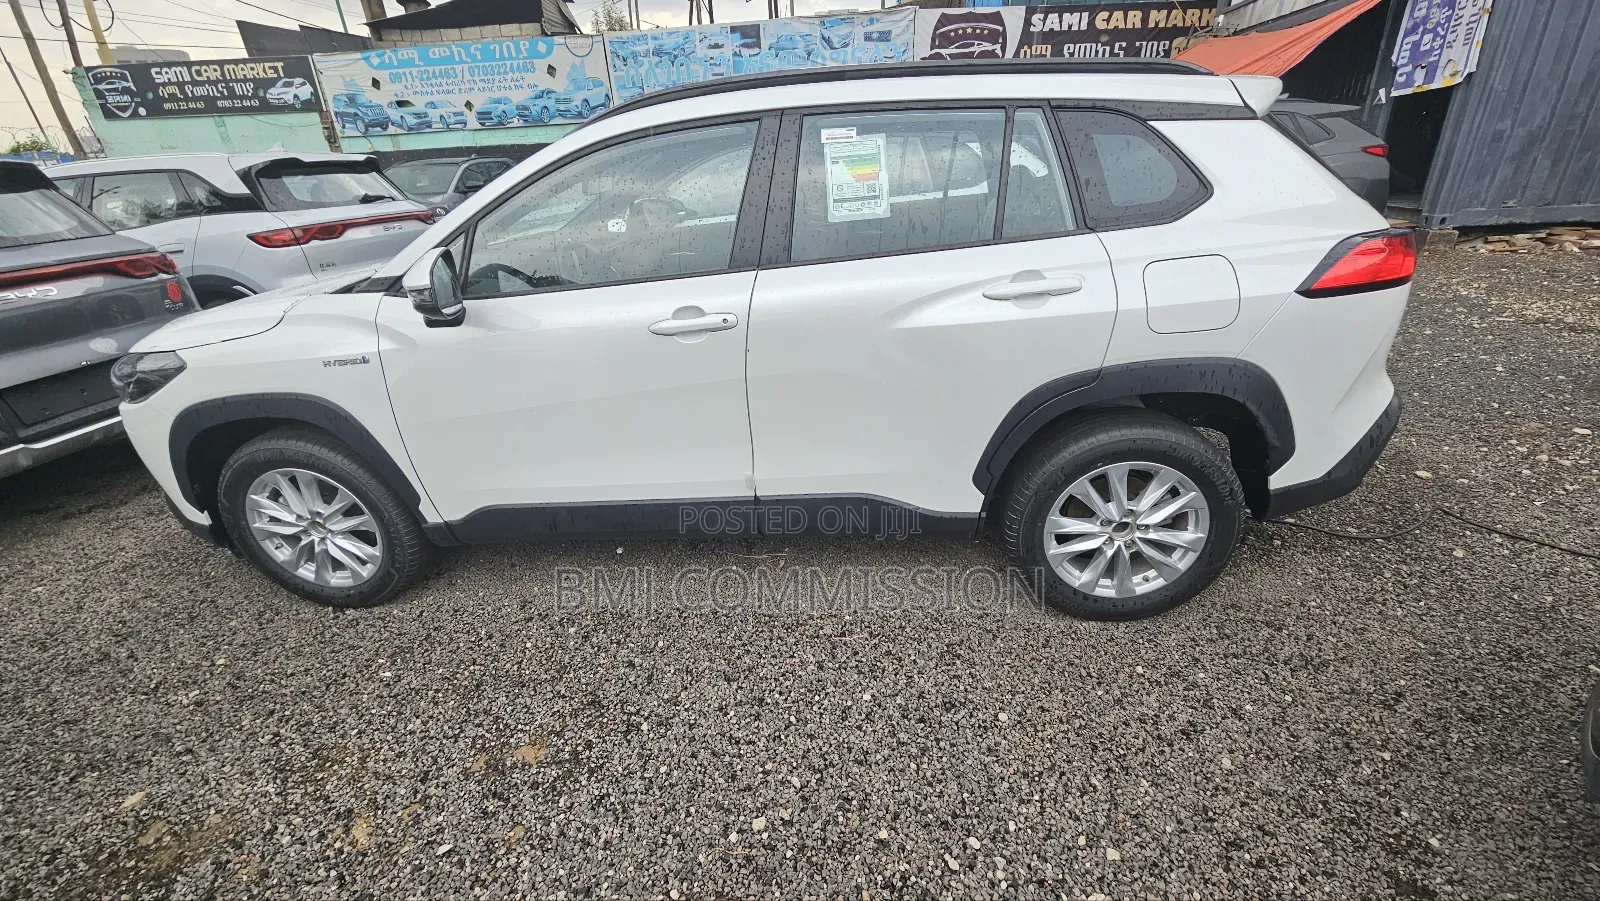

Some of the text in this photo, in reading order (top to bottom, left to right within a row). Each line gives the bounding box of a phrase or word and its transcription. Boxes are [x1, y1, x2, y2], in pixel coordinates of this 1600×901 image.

[1030, 12, 1089, 31] SAMI
[1095, 10, 1143, 29] CAR
[384, 40, 530, 66] ሳሚ መኪና ገበያ
[151, 62, 285, 83] SAMI CAR MARKET
[467, 61, 536, 77] 0703224463
[158, 82, 254, 99] ሳሚ የመኪና ገበያ
[163, 101, 205, 110] 0911 22 44 63
[242, 99, 251, 107] 44
[251, 99, 259, 107] 63
